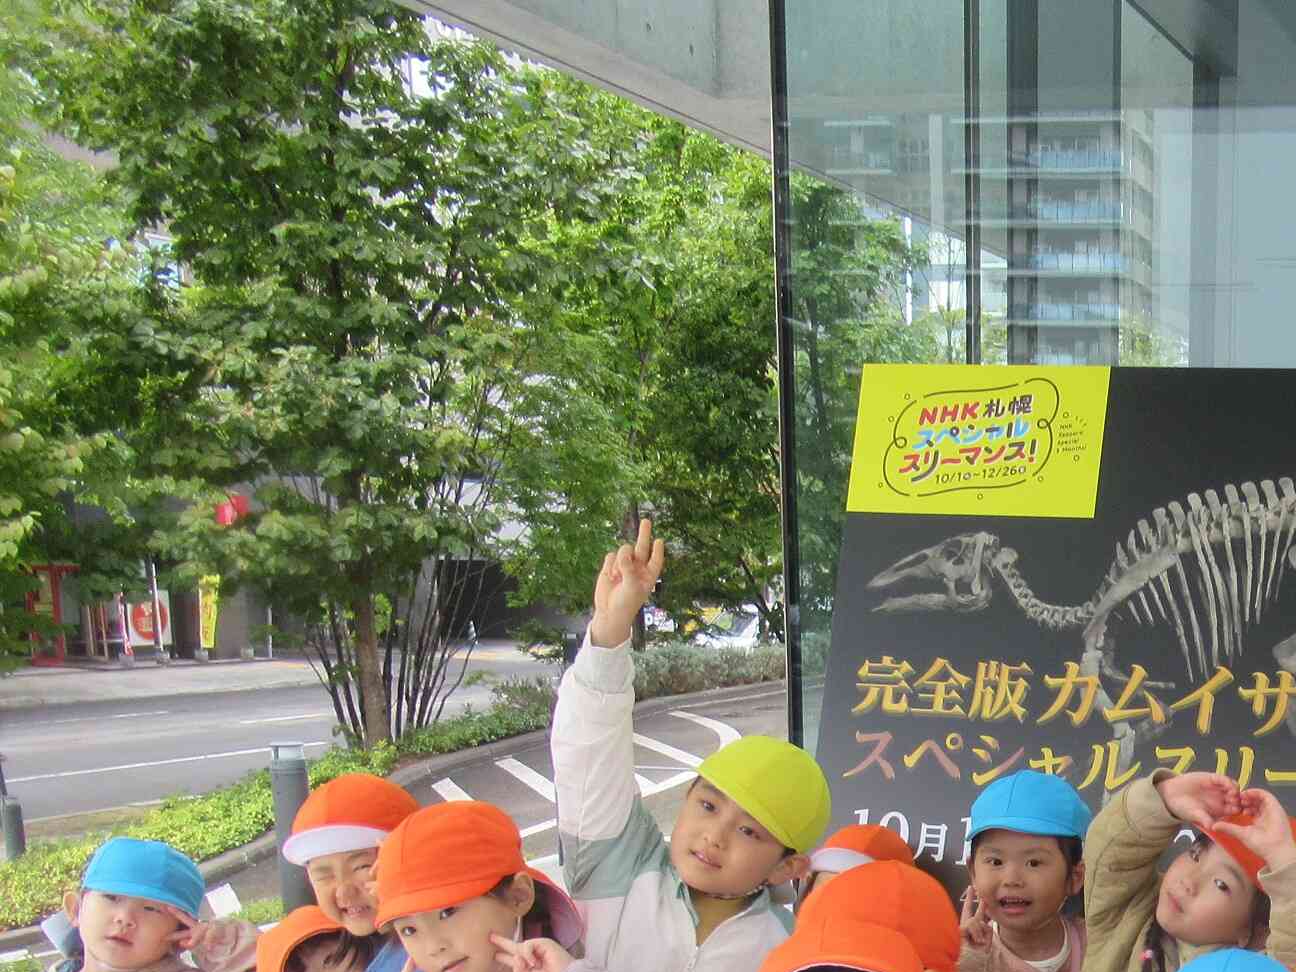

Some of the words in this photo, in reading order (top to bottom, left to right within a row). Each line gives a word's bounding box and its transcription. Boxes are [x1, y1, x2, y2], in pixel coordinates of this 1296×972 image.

[911, 416, 1029, 450] スペシャル
[898, 439, 1036, 482] スリーマンス！
